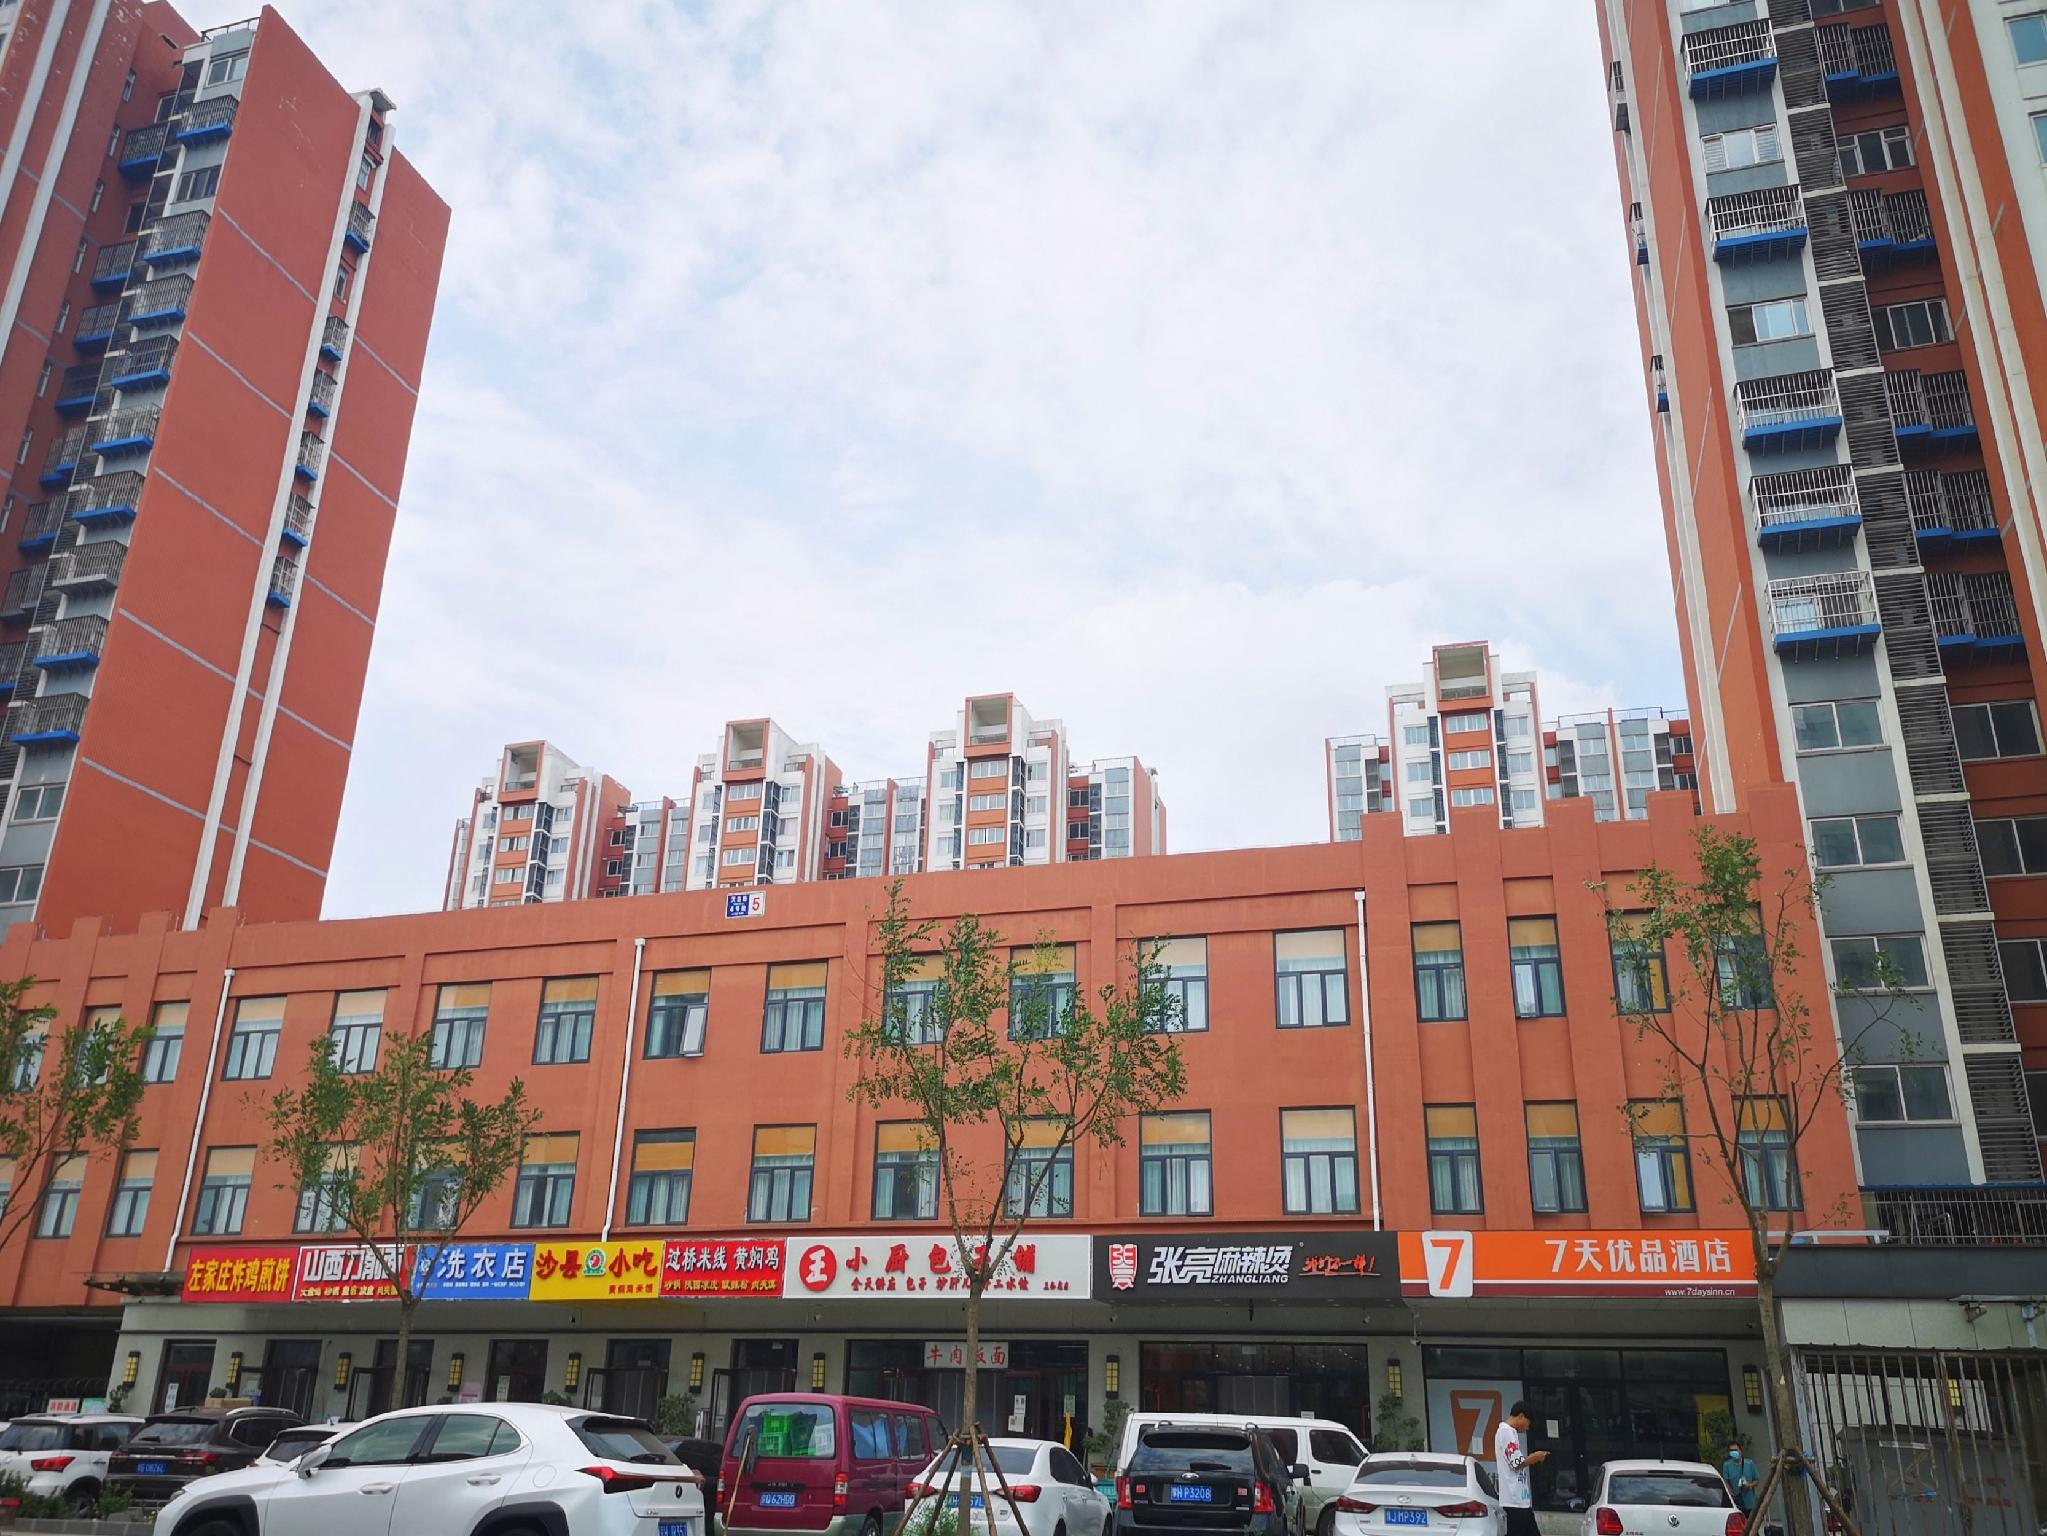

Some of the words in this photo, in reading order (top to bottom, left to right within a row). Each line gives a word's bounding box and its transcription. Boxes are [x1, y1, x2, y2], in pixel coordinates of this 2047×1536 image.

[752, 897, 761, 911] 5
[437, 1248, 527, 1279] 洗衣店
[536, 1249, 582, 1279] 沙县
[608, 1247, 658, 1278] 小吃
[665, 1246, 728, 1272] 过桥米线
[733, 1245, 779, 1270] 黄焖鸡
[806, 1249, 828, 1283] 王
[1147, 1245, 1293, 1284] 张亮麻辣烫
[1430, 1239, 1464, 1290] 7
[1544, 1238, 1732, 1273] 7天优品酒店
[187, 1257, 291, 1292] 左家庄炸鸡煎饼
[1211, 1274, 1289, 1284] ZHANGLIANG
[1664, 1287, 1736, 1297] www.7daysinn.cn
[1457, 1399, 1495, 1455] 7
